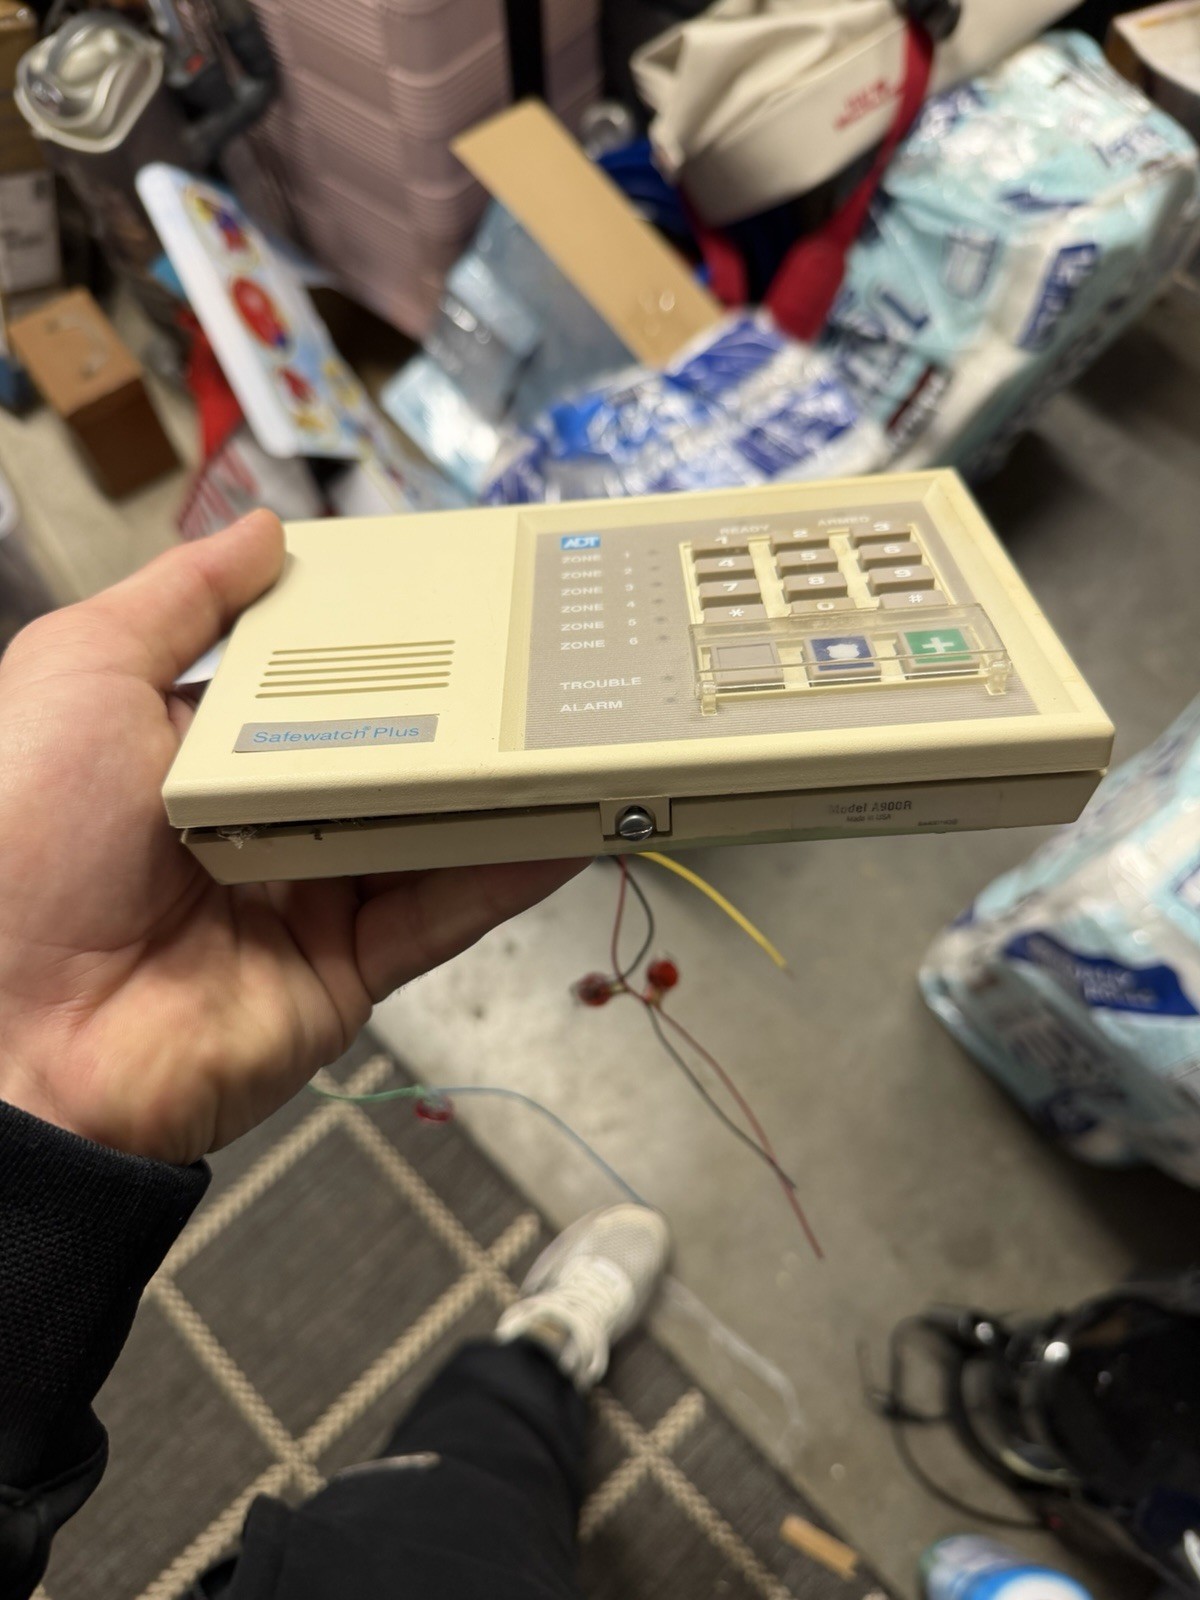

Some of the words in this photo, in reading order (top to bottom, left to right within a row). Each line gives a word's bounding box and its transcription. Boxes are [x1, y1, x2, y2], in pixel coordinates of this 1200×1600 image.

[819, 517, 870, 527] ARMED
[873, 522, 891, 532] 3
[720, 525, 769, 535] READY
[793, 529, 809, 539] 2
[563, 537, 600, 548] ADT
[714, 535, 728, 545] 1
[883, 544, 902, 555] 6
[561, 554, 602, 565] ZONE
[800, 551, 817, 562] 5
[718, 557, 735, 568] 4
[561, 570, 603, 580] ZONE
[624, 567, 633, 575] 2
[894, 568, 912, 579] 9
[808, 575, 826, 586] 8
[561, 586, 604, 596] ZONE
[625, 584, 634, 592] 3
[722, 582, 739, 592] 7
[561, 603, 605, 613] ZONE
[560, 621, 605, 631] ZONE
[628, 619, 637, 627] 5
[560, 640, 606, 650] ZONE
[629, 637, 639, 646] 6
[559, 677, 643, 690] TROUBLE
[559, 700, 623, 713] ALARM
[373, 726, 420, 739] Plus
[828, 803, 867, 815] Model
